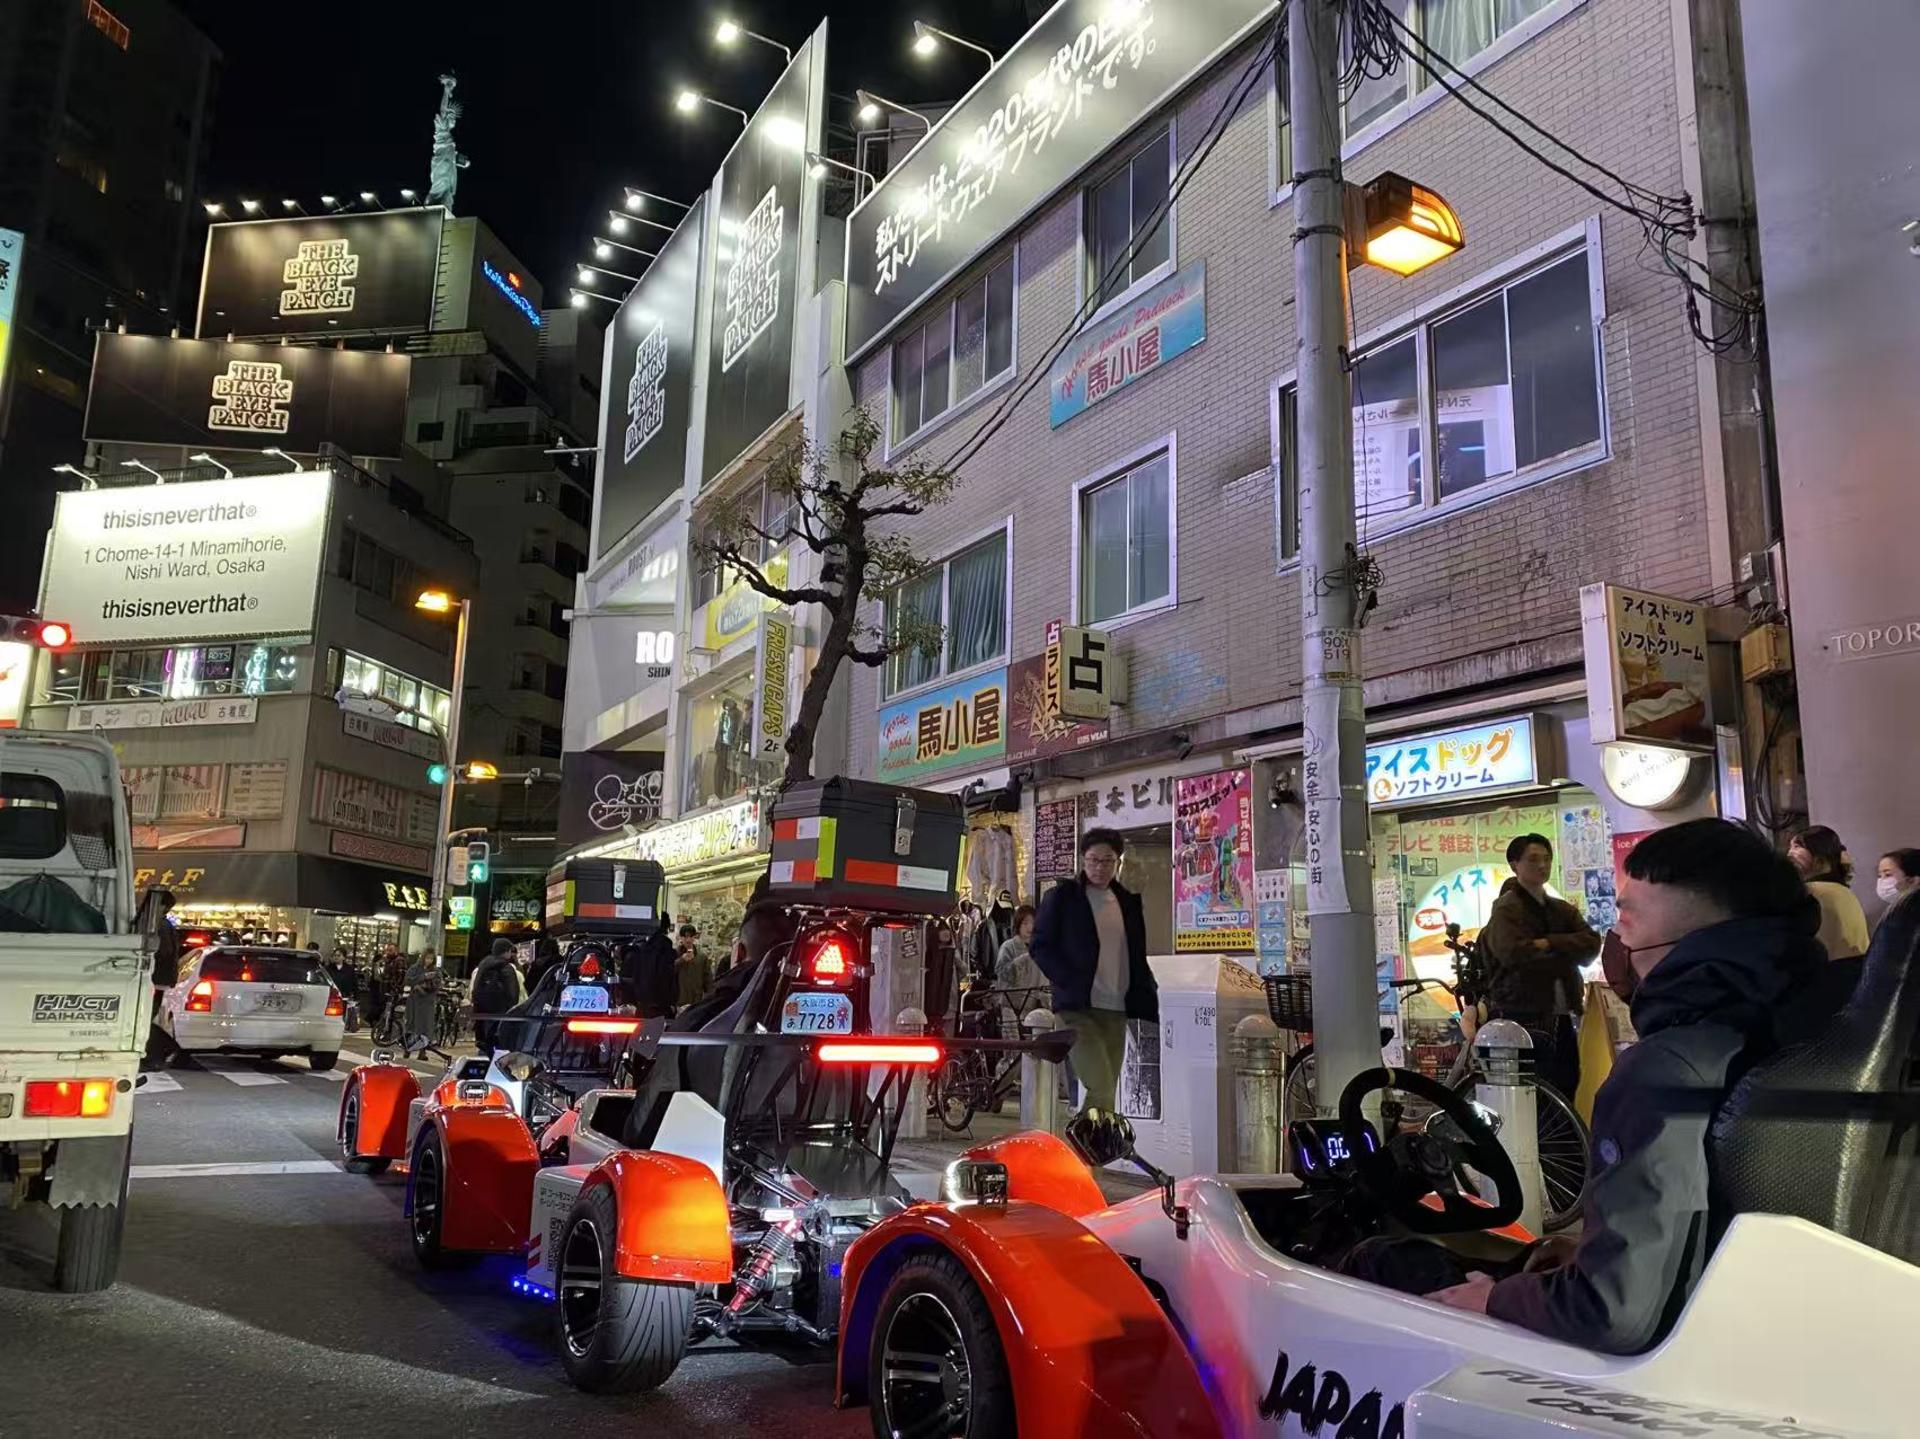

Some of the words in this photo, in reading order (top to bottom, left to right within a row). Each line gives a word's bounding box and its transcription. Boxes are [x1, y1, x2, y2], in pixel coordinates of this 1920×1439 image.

[301, 243, 343, 260] THE
[729, 215, 780, 298] BLACK
[288, 258, 352, 277] BLACK
[299, 275, 337, 292] EYE
[738, 265, 769, 313] EYE
[284, 289, 350, 310] PATCH
[725, 280, 775, 363] PATCH
[232, 363, 276, 382] THE
[631, 346, 666, 406] BLACK
[1087, 327, 1160, 402] 馬小屋
[217, 379, 288, 399] BLACK
[635, 381, 656, 423] EYE
[230, 395, 271, 412] EYE
[212, 409, 284, 430] PATCH
[626, 396, 663, 457] PATCH
[84, 550, 90, 564] 1
[95, 541, 185, 564] Chome-14-1
[190, 535, 287, 557] Minamihorie,
[125, 563, 162, 581] Nishi
[167, 561, 210, 578] Ward,
[216, 558, 265, 575] Osaka
[1622, 596, 1694, 625] アイスドッグ
[1048, 623, 1060, 646] 占
[1658, 622, 1666, 635] &
[635, 631, 675, 664] RO
[765, 619, 787, 686] FRESH
[1621, 631, 1704, 661] ソフトクリーム
[1069, 633, 1105, 694] 占
[762, 686, 784, 738] CAPS
[917, 688, 1000, 761] 馬小屋
[763, 738, 779, 752] 2F
[1366, 727, 1514, 779] アイスドッグ
[1395, 768, 1495, 796] ソフトクリーム
[1387, 835, 1433, 852] テレビ
[1439, 834, 1474, 853] 雑誌
[35, 1012, 116, 1021] DAIHATSU
[37, 995, 120, 1010] HIJET
[571, 998, 597, 1009] 7726
[799, 1012, 835, 1030] 7728
[1478, 1369, 1687, 1413] FUTURE
[1681, 1411, 1845, 1439] KAR
[1526, 1397, 1712, 1438] OSAKA
